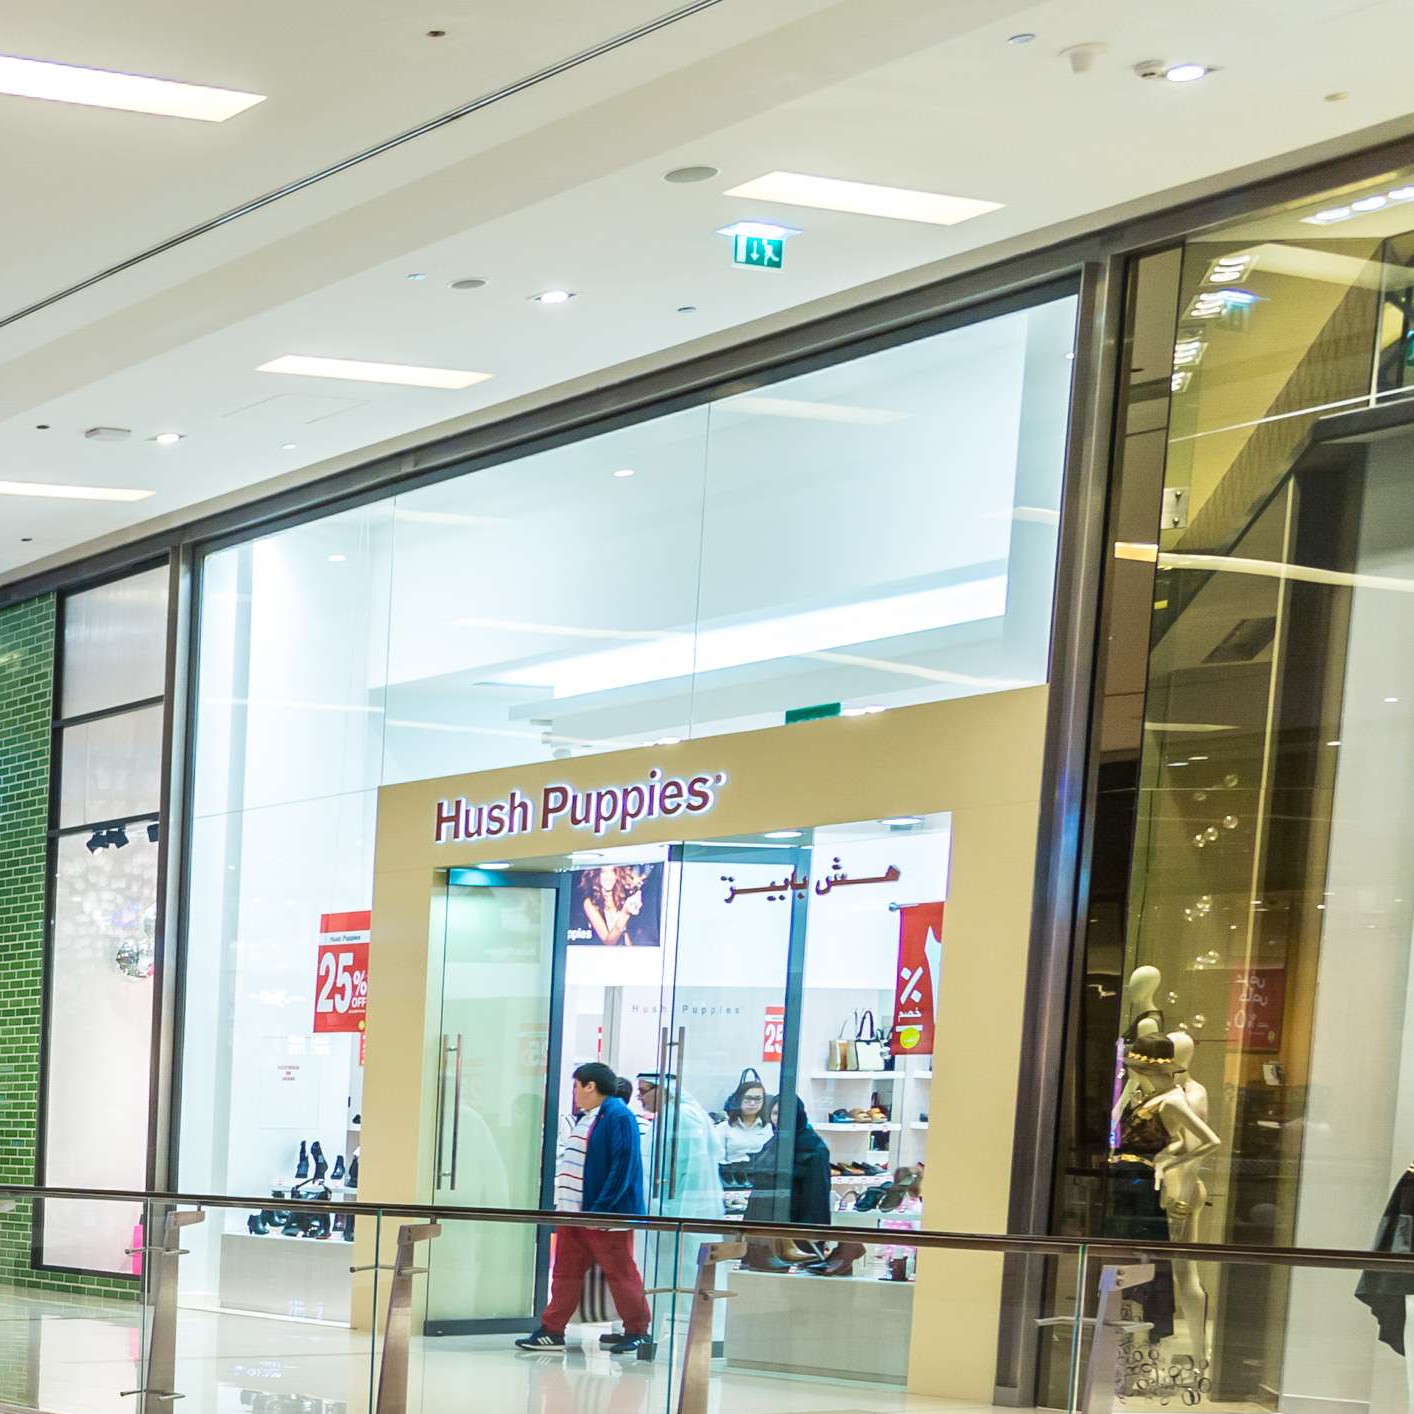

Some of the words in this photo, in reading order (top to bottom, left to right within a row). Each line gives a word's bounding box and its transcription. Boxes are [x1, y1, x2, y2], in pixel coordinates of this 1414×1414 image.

[435, 794, 528, 844] Hush
[541, 770, 713, 833] Puppies
[568, 929, 592, 940] ppies
[352, 997, 366, 1008] OFF
